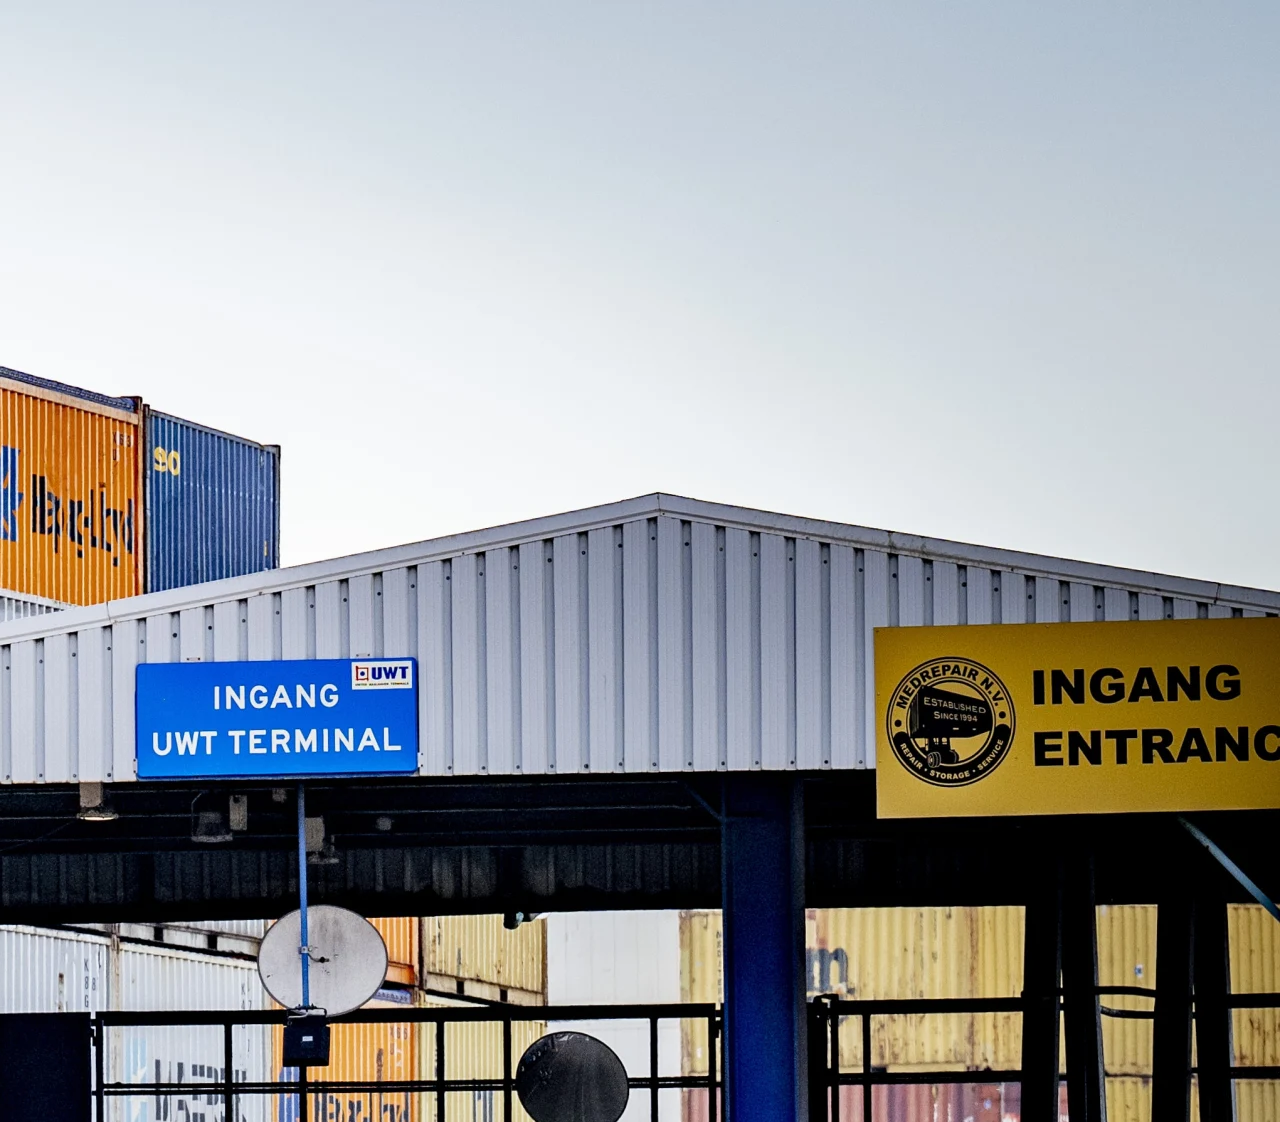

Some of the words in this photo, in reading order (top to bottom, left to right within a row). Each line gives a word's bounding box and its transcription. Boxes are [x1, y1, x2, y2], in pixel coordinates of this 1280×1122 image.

[371, 665, 409, 680] UWT
[895, 663, 980, 710] MEDREPAIR
[979, 676, 1005, 707] N.V.
[1032, 664, 1241, 706] INGANG
[213, 683, 339, 710] INGANG
[923, 696, 987, 714] ESTABLISHED
[959, 713, 978, 723] 1994
[152, 730, 218, 757] UWT
[228, 726, 402, 755] TERMINAL
[1033, 723, 1280, 767] ENTRANC
[900, 742, 924, 770] REPAIR
[929, 769, 971, 780] STORAGE
[977, 738, 1004, 771] SERVICE
